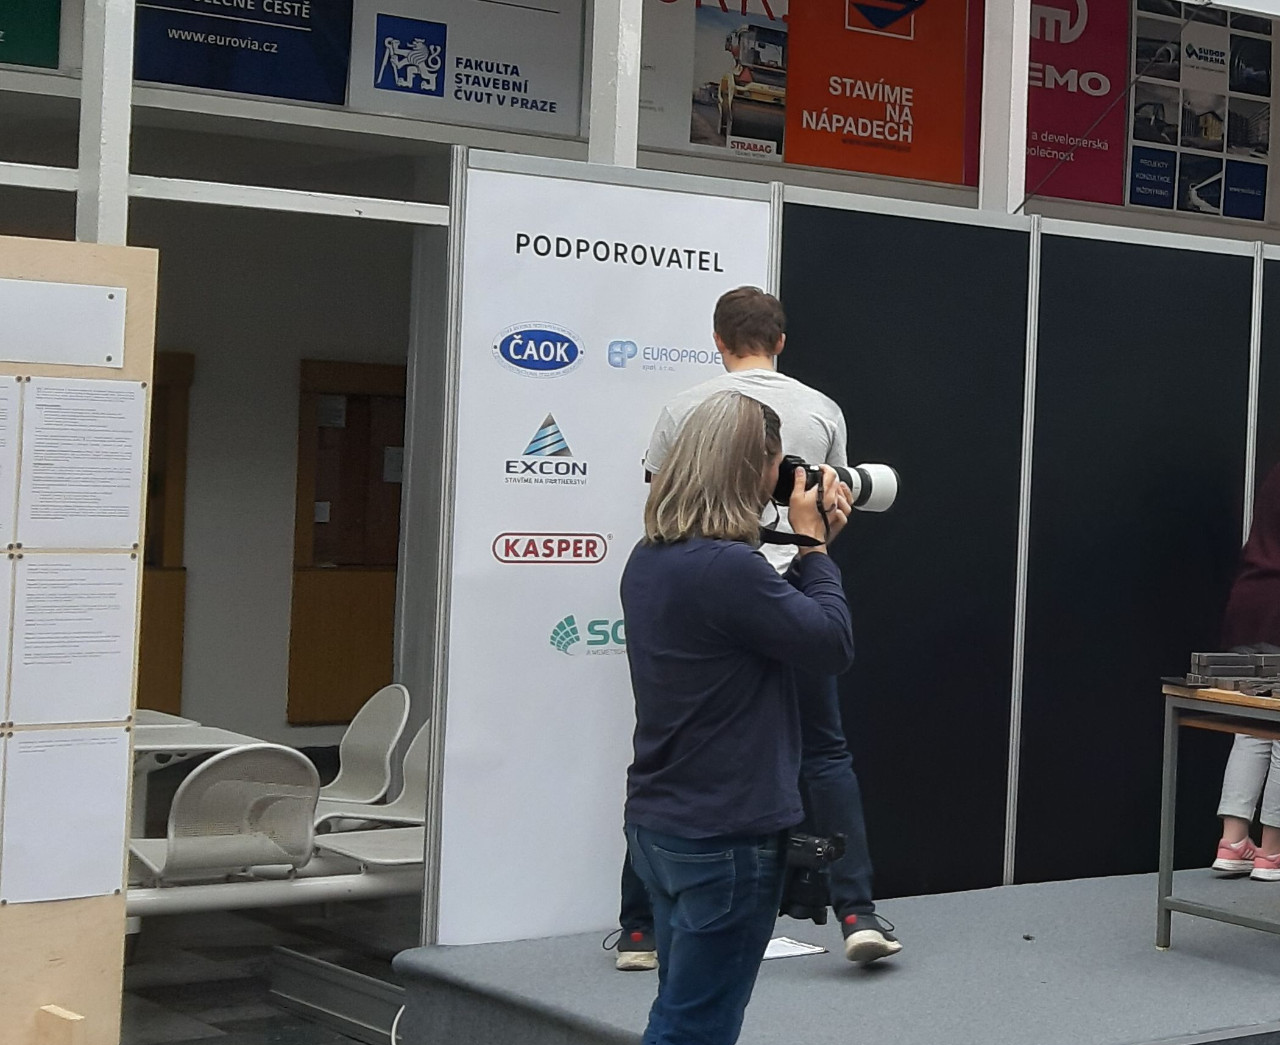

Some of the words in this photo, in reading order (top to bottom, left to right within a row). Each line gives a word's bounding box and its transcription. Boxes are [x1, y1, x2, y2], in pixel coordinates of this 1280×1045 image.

[167, 28, 278, 53] www.eurovia.cz
[455, 57, 520, 77] FAKULTA
[454, 73, 529, 94] STAVEBNÍ
[1030, 62, 1111, 97] EMO
[454, 85, 493, 105] ČVUT
[496, 94, 506, 106] V
[510, 96, 557, 113] PRAZE
[829, 76, 913, 107] STAVÍME
[886, 104, 914, 125] NA
[802, 107, 913, 144] NÁPADECH
[730, 140, 772, 154] STRABAG
[1027, 144, 1075, 161] olečnost
[515, 232, 724, 273] PODPOROVATEL
[509, 334, 570, 363] ČAOK
[642, 346, 721, 365] EUROPROJE
[505, 460, 587, 476] EXCON
[504, 538, 598, 558] KASPER
